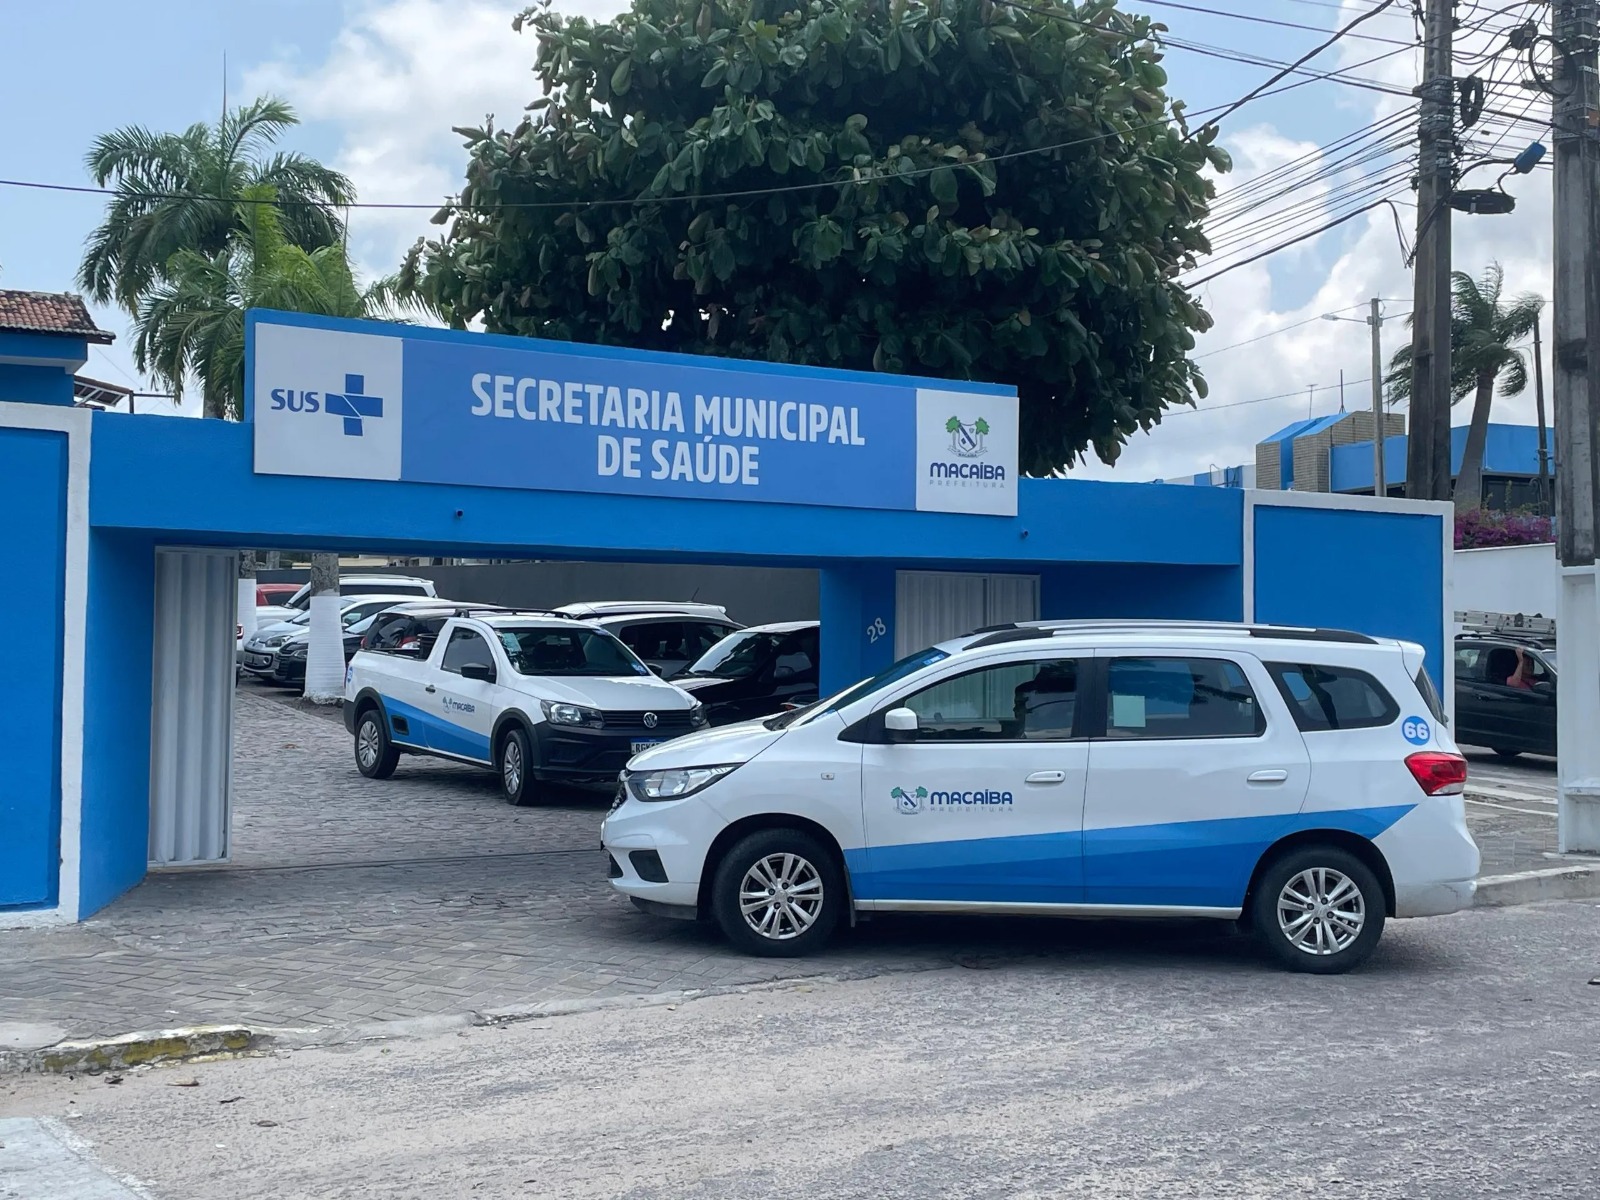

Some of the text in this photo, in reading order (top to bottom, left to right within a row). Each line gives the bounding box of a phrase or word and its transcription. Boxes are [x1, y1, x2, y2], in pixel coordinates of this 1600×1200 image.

[271, 389, 319, 412] SUS
[471, 373, 865, 445] SECRETARIA MUNICIPAL
[597, 435, 759, 485] DE SAÚDE
[930, 461, 1005, 480] MACAÍBA
[929, 480, 1005, 488] PREFEITURA
[867, 617, 886, 643] 28
[1404, 721, 1429, 740] 66
[930, 789, 1013, 805] MACAÍBA
